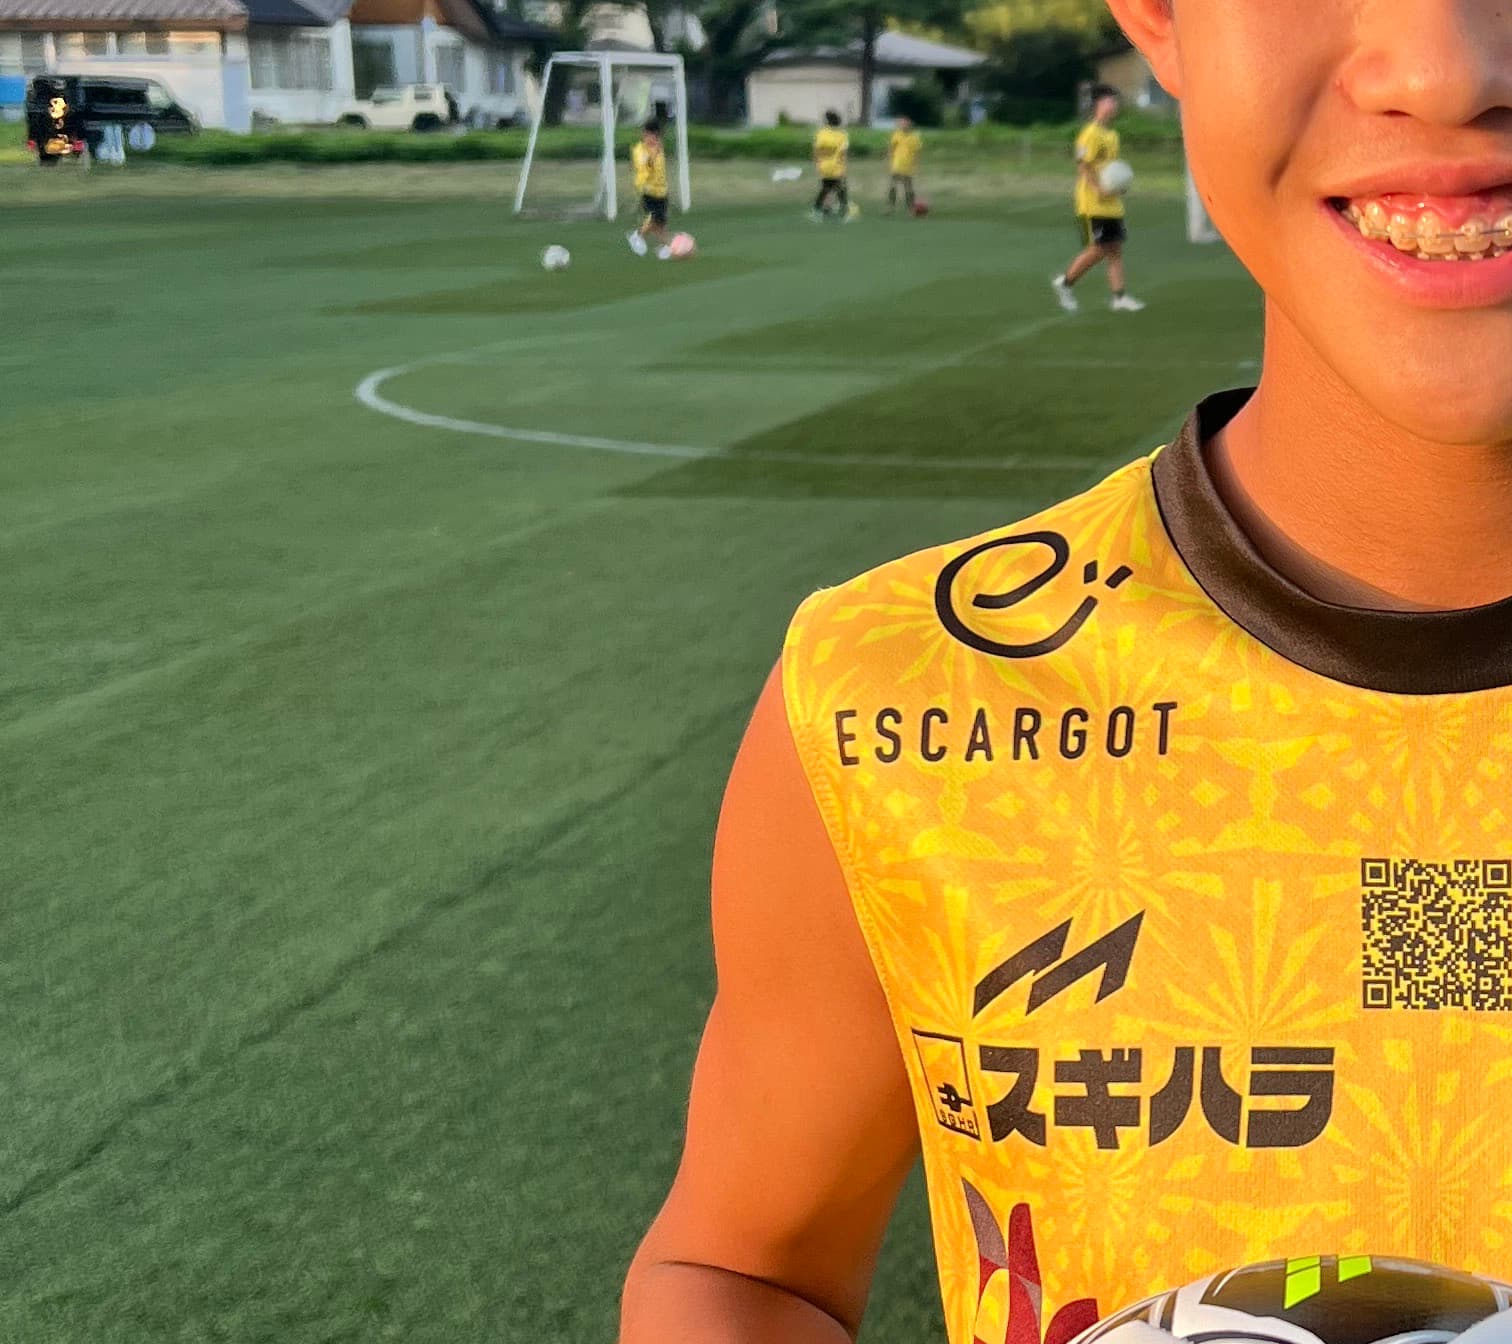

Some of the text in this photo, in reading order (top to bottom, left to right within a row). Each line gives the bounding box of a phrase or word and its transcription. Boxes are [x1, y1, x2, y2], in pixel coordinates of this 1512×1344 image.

[834, 701, 1178, 766] ESCARGOT
[978, 1044, 1336, 1150] スギハラ
